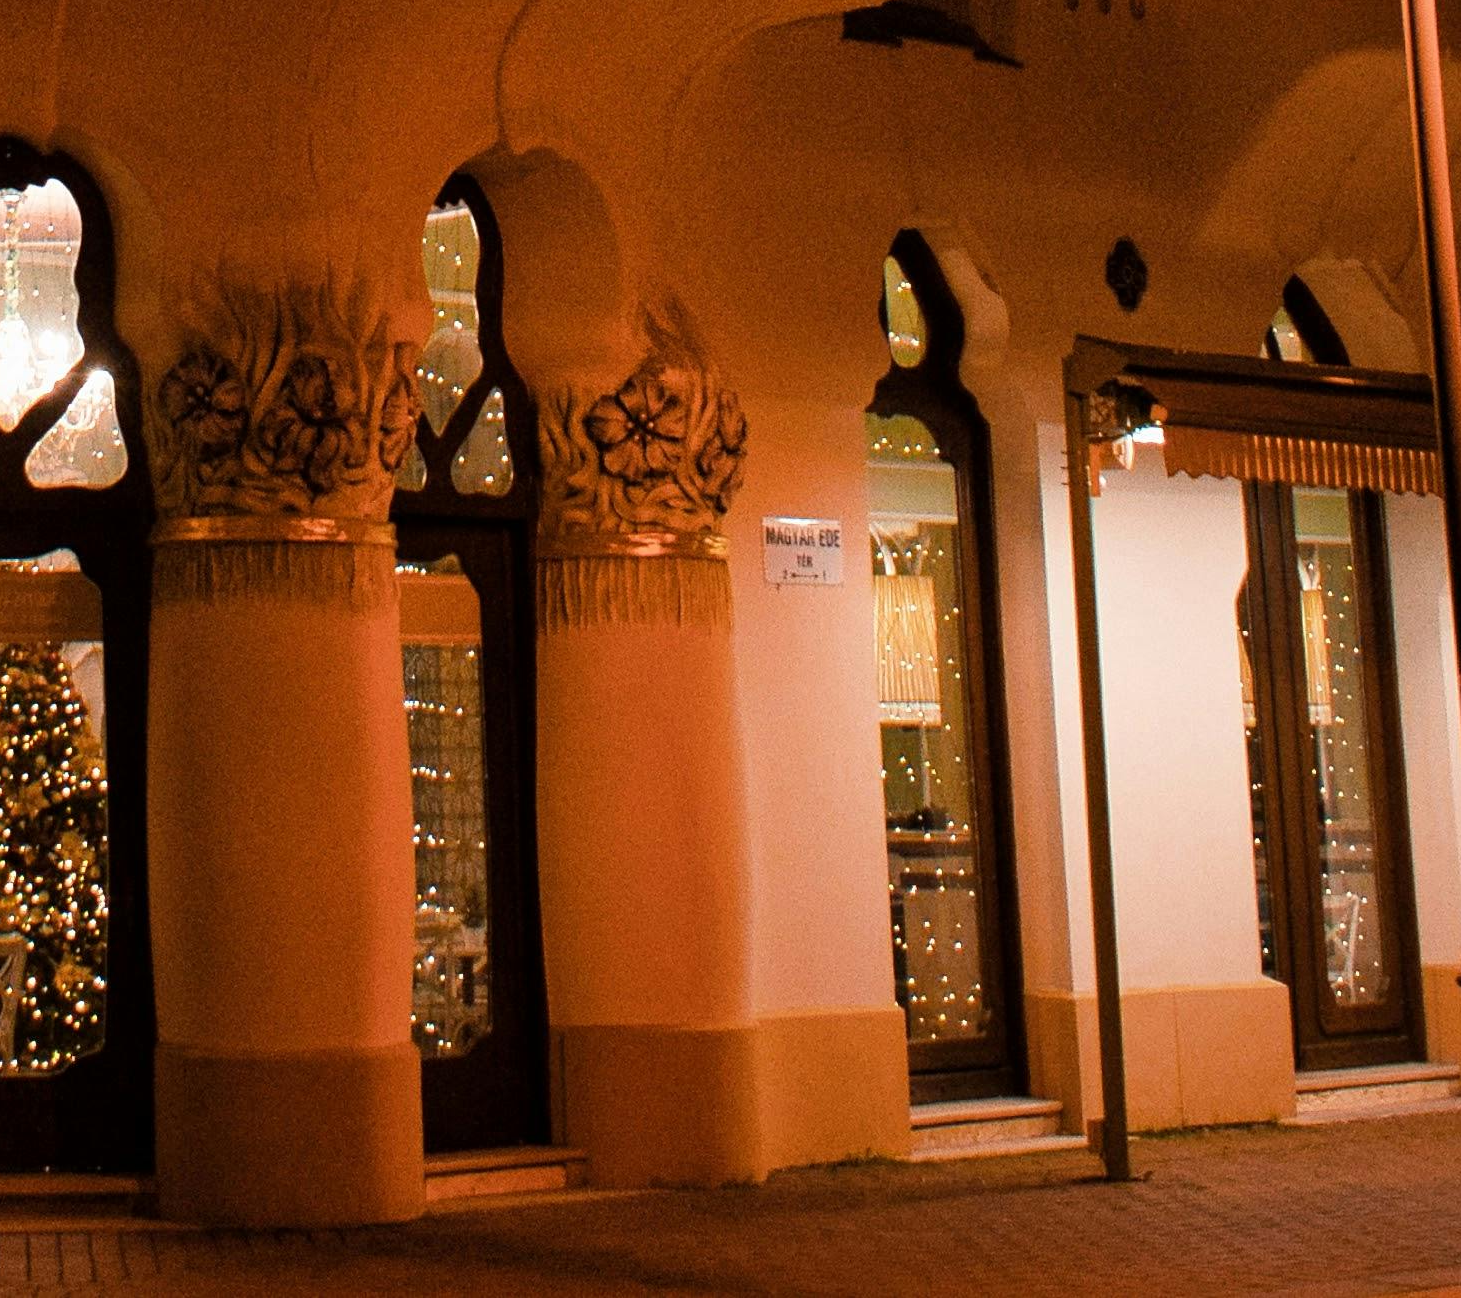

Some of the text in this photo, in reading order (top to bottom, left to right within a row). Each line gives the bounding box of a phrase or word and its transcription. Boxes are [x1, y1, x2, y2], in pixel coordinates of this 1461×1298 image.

[765, 526, 840, 548] MAGYAR EDE
[796, 552, 813, 568] TÉR
